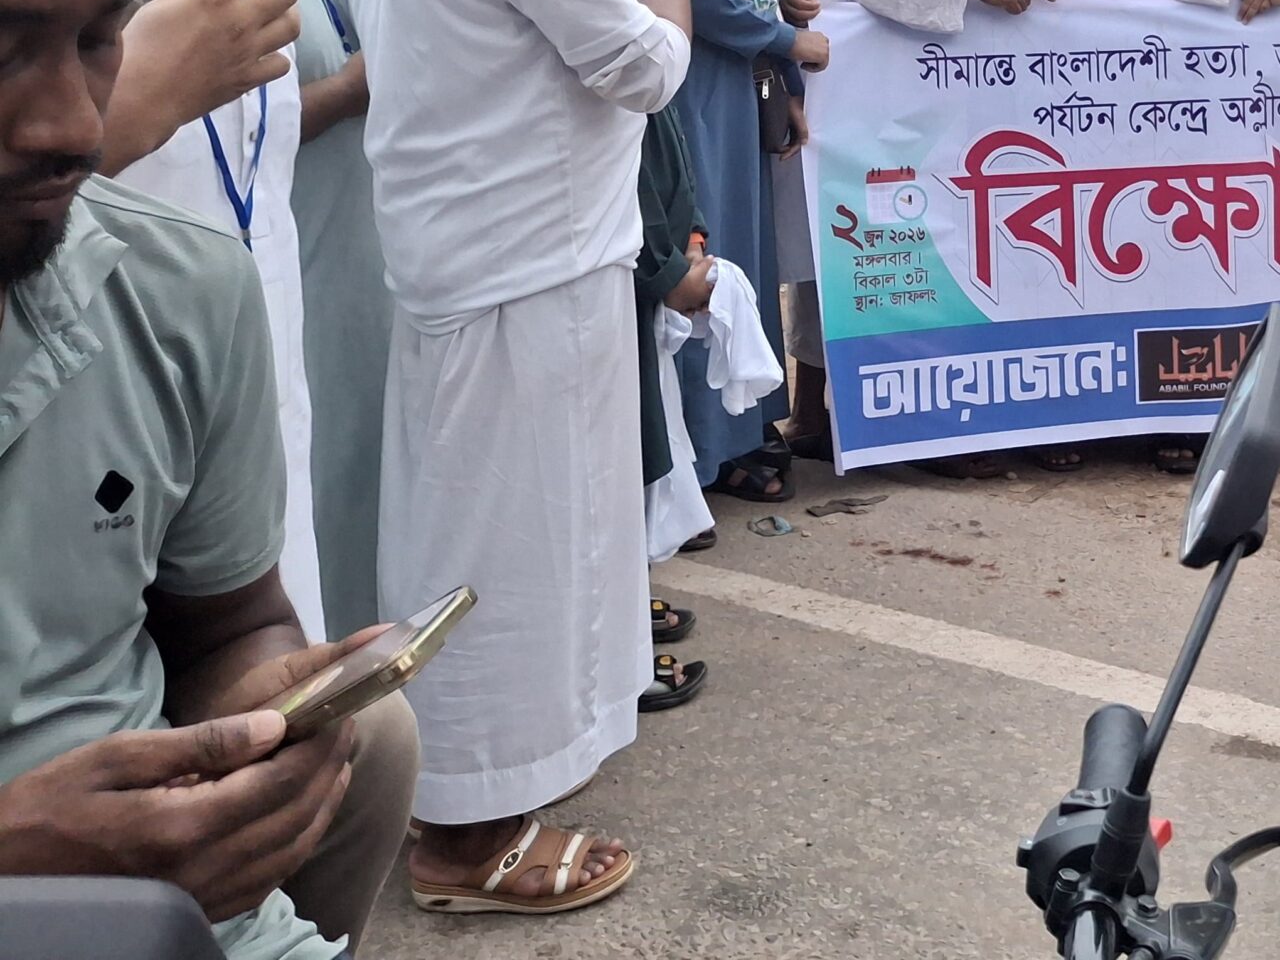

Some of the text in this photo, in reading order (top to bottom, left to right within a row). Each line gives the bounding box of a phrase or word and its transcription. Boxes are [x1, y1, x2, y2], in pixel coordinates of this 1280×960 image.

[916, 43, 1016, 89] সীমান্তে
[1025, 35, 1172, 86] বাংলাদেশী
[1034, 91, 1117, 137] পর্যটন
[1129, 99, 1210, 136] কেন্দ্রে
[831, 204, 926, 251] ২ জুন ২০২৬
[853, 251, 911, 269] মঙ্গলবার
[854, 267, 929, 291] বিকাল ৩টা
[853, 289, 938, 312] স্থান: জাফলং
[859, 341, 1129, 422] আয়োজনে:
[1159, 384, 1191, 393] ABABIL
